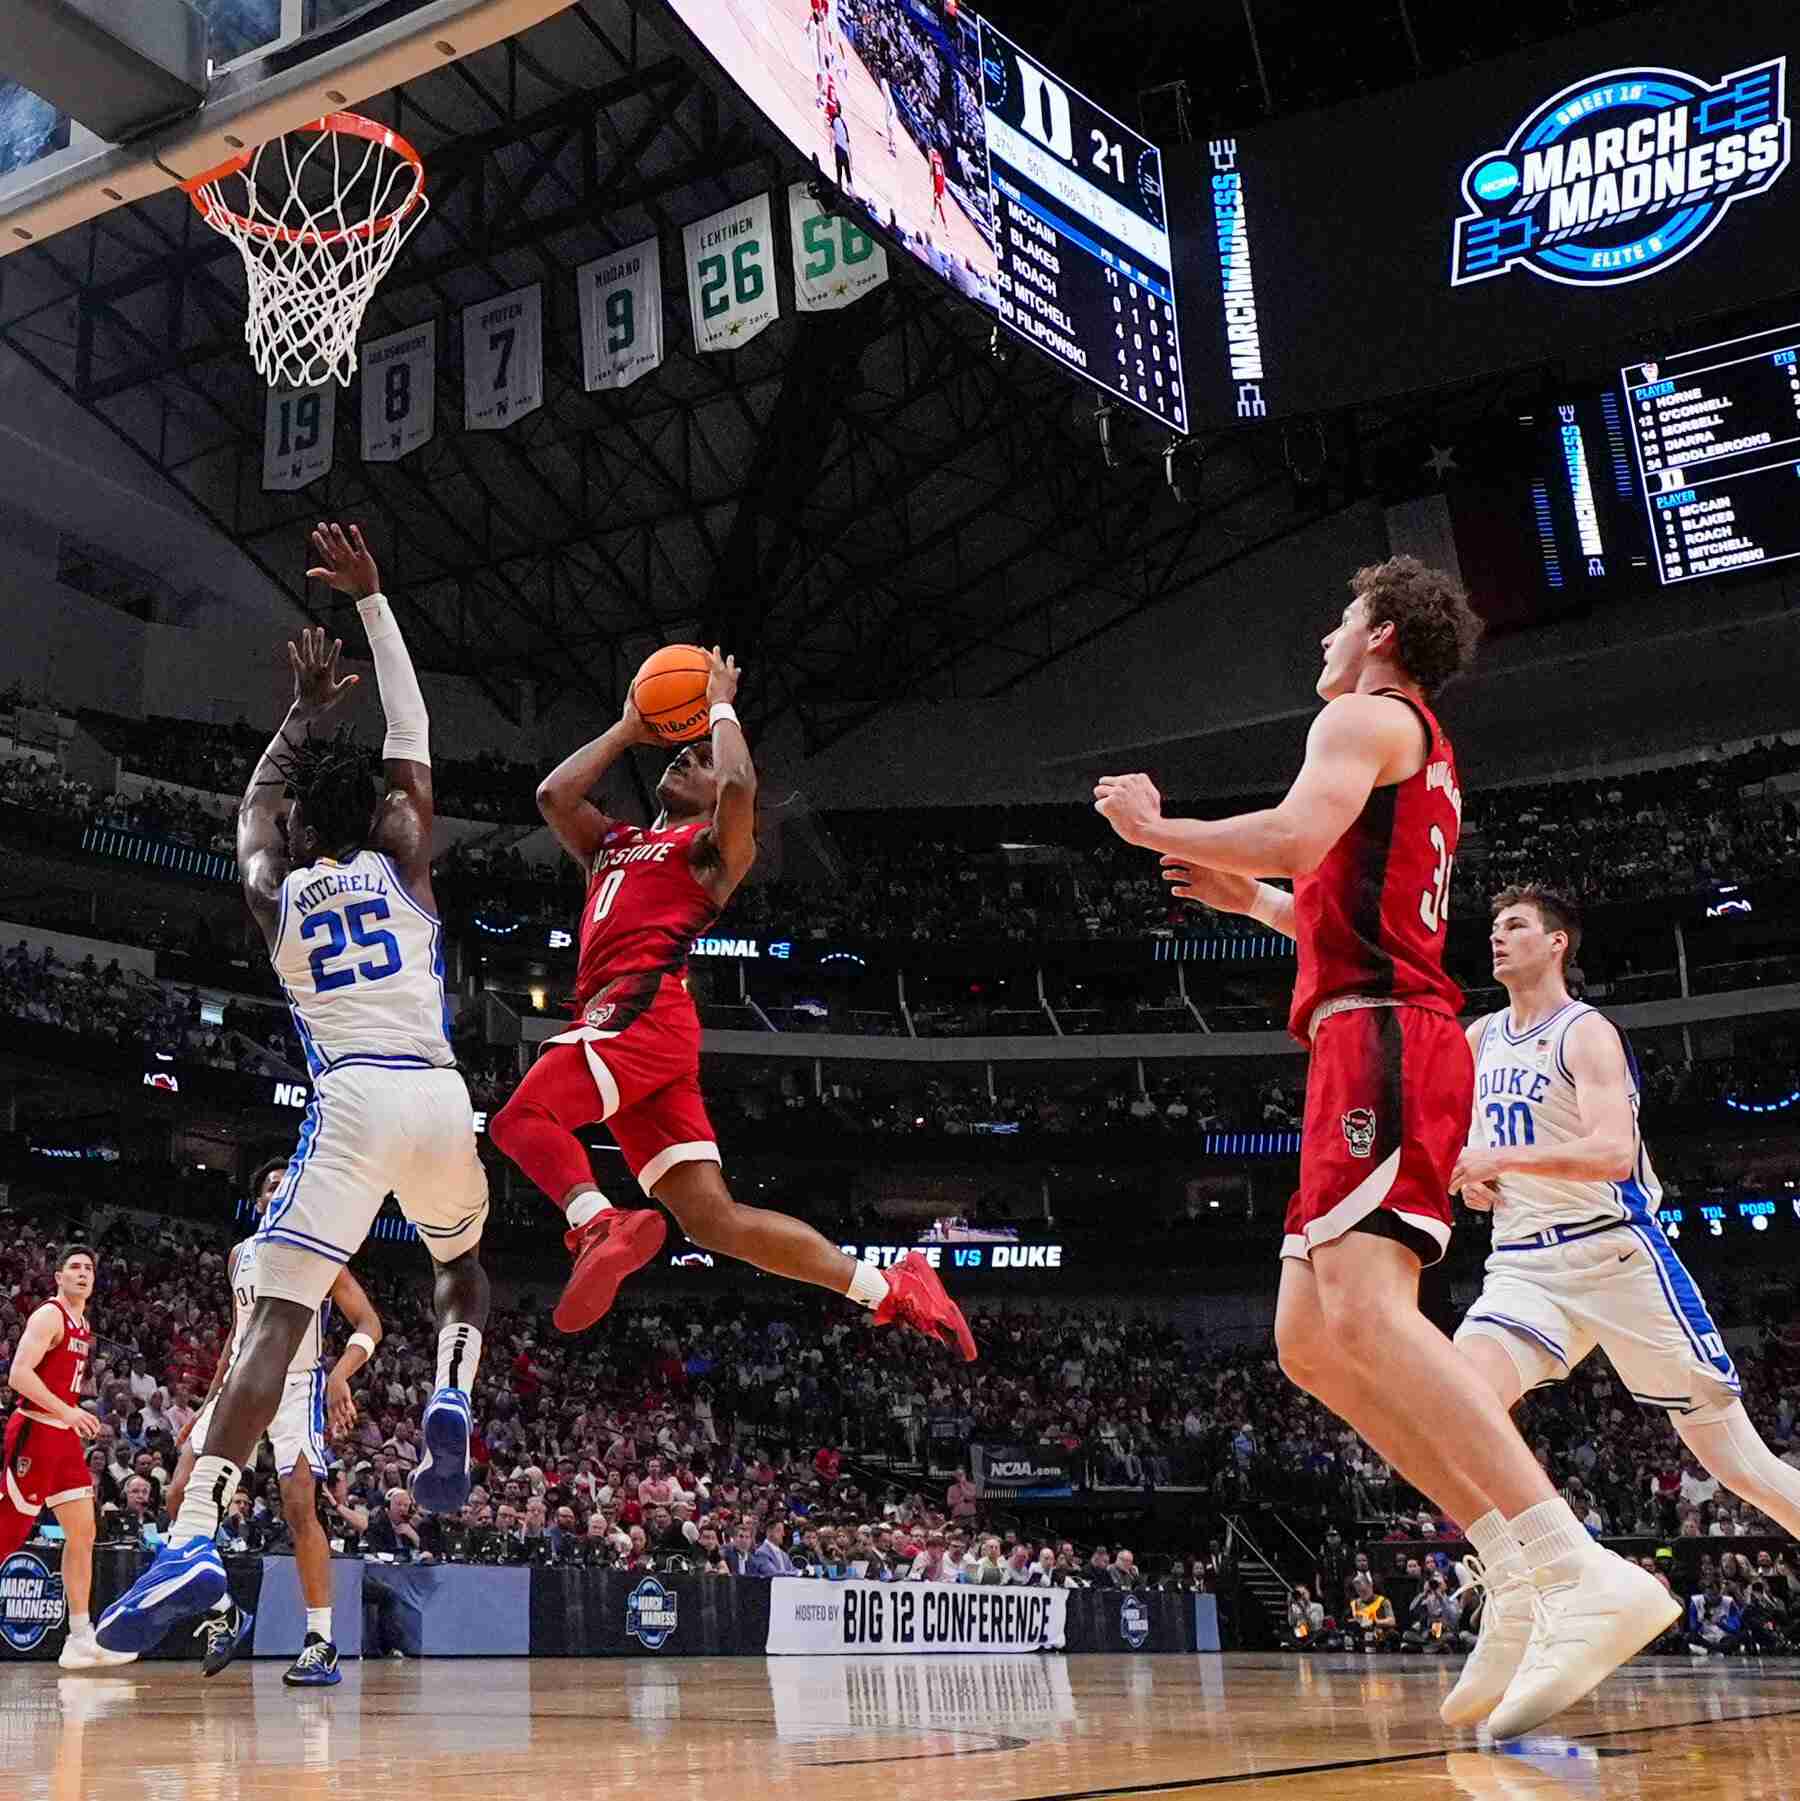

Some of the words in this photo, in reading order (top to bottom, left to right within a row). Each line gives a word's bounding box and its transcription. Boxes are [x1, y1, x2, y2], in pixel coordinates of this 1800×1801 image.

[1015, 54, 1073, 160] D
[1091, 129, 1125, 183] 21
[1556, 87, 1614, 126] SWEET
[1522, 106, 1688, 195] MARCH
[1548, 123, 1779, 232] MADNESS
[700, 217, 754, 250] LEHTINEN
[1008, 200, 1057, 248] MCCAIN
[1105, 267, 1118, 287] 11
[1129, 282, 1137, 299] 0
[1148, 294, 1156, 310] 0
[1164, 305, 1172, 321] 0
[1591, 243, 1646, 268] ELITE
[697, 239, 765, 321] 26
[994, 216, 1002, 233] 2
[1010, 228, 1060, 274] BLAKES
[1113, 296, 1121, 312] 0
[1132, 308, 1139, 324] 1
[1150, 319, 1158, 336] 0
[1166, 330, 1175, 346] 2
[606, 288, 635, 355] 9
[995, 242, 1004, 260] 3
[1012, 254, 1057, 298] ROACH
[1115, 322, 1124, 339] 4
[1134, 333, 1142, 350] 0
[1152, 345, 1160, 361] 0
[1169, 355, 1177, 371] 0
[997, 270, 1012, 292] 25
[1014, 281, 1076, 336] MITCHELL
[1117, 348, 1126, 365] 4
[1136, 359, 1145, 376] 2
[1154, 370, 1163, 387] 0
[1171, 381, 1180, 397] 0
[489, 327, 516, 392] 7
[999, 296, 1014, 319] 30
[1016, 308, 1087, 368] FILIPOWSKI
[1119, 373, 1128, 391] 2
[1157, 395, 1164, 412] 1
[1174, 406, 1182, 422] 0
[385, 362, 411, 424] 8
[1635, 382, 1676, 400] PLAYER
[1656, 388, 1703, 409] HORNE
[278, 392, 321, 457] 19
[1639, 415, 1654, 427] 12
[1659, 397, 1733, 422] O'CONNELL
[1642, 430, 1657, 442] 14
[1661, 414, 1724, 437] MORSELL
[1643, 444, 1659, 457] 23
[1664, 430, 1715, 451] DIARRA
[1646, 458, 1662, 471] 34
[1666, 432, 1771, 467] MIDDLEBROOKS
[1656, 490, 1697, 509] PLAYER
[1678, 496, 1732, 518] MCCAIN
[1665, 524, 1675, 536] 2
[1681, 510, 1735, 532] BLAKES
[1668, 537, 1678, 549] 3
[1684, 525, 1733, 546] ROACH
[1664, 552, 1681, 564] 25
[1687, 536, 1753, 560] MITCHELL
[1667, 566, 1683, 578] 30
[1689, 547, 1765, 574] FILIPOWSKI
[610, 842, 676, 866] STATE
[294, 873, 389, 918] MITCHELL
[592, 868, 626, 924] 0
[300, 897, 403, 994] 25
[690, 937, 760, 957] IONAL
[273, 1082, 307, 1108] NC
[1479, 1067, 1552, 1105] DUKE
[1485, 1101, 1536, 1148] 30
[1701, 1206, 1727, 1220] TOL
[1739, 1201, 1776, 1216] POSS
[1667, 1222, 1680, 1239] 4
[1710, 1219, 1723, 1236] 3
[864, 1246, 942, 1268] STAE
[954, 1249, 981, 1267] VS
[991, 1246, 1062, 1268] DUKE
[990, 1461, 1061, 1478] NCAA.com
[0, 1577, 44, 1598] MARCH
[6, 1598, 64, 1619] MADNESS
[795, 1604, 827, 1621] HOSTED
[828, 1604, 840, 1621] BY
[843, 1589, 884, 1644] BIG
[890, 1591, 914, 1643] 12
[922, 1591, 1052, 1644] CONFERENCE
